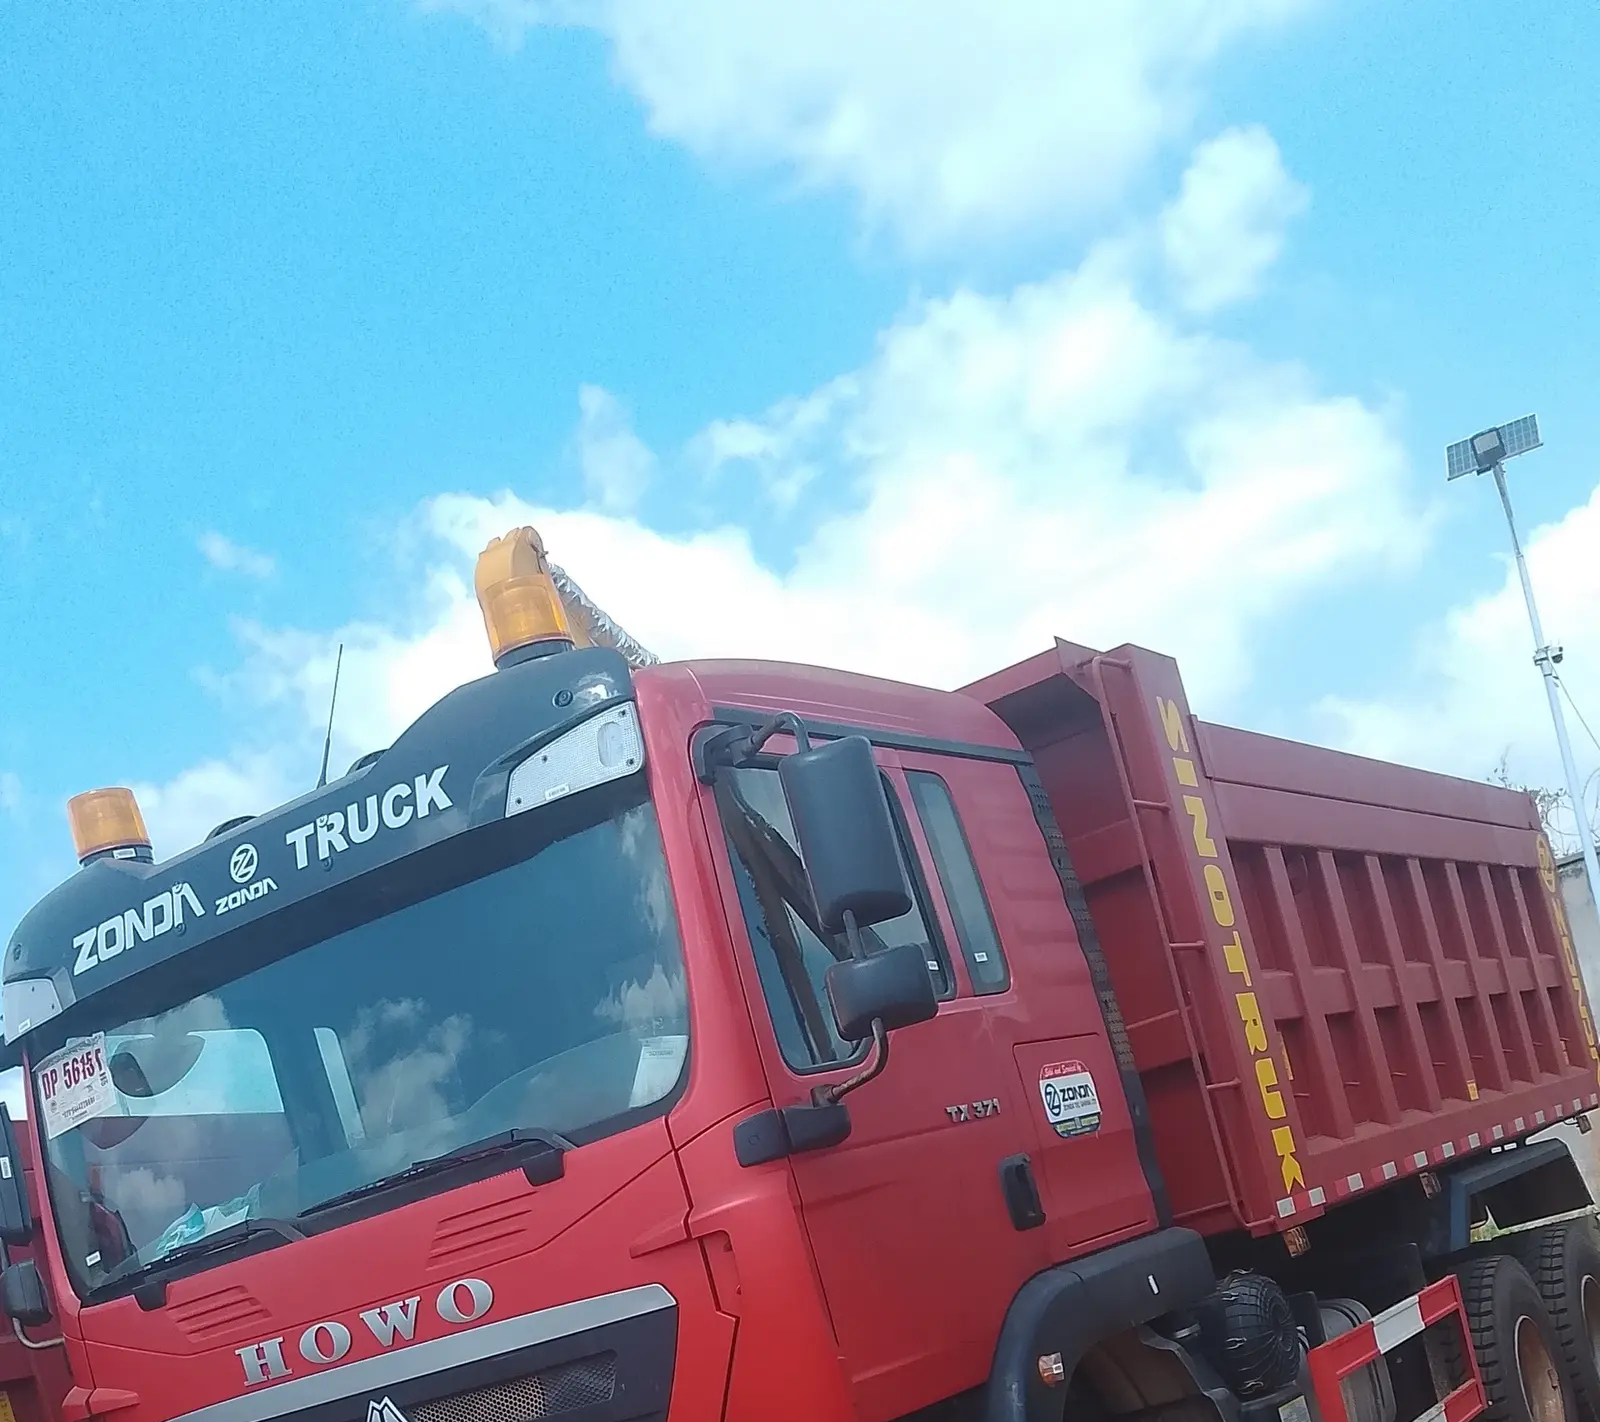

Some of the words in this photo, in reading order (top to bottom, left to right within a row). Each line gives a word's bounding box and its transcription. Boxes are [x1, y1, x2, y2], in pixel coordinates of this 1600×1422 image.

[73, 882, 205, 976] ZONDA
[286, 765, 453, 870] TRUCK
[215, 877, 278, 916] ZONDA
[1156, 696, 1305, 1194] SINOTRUK
[41, 1068, 58, 1100] DP
[1059, 1084, 1094, 1102] ZONDA
[945, 1104, 971, 1122] TX
[972, 1098, 1000, 1118] 371
[235, 1278, 494, 1387] HOWO
